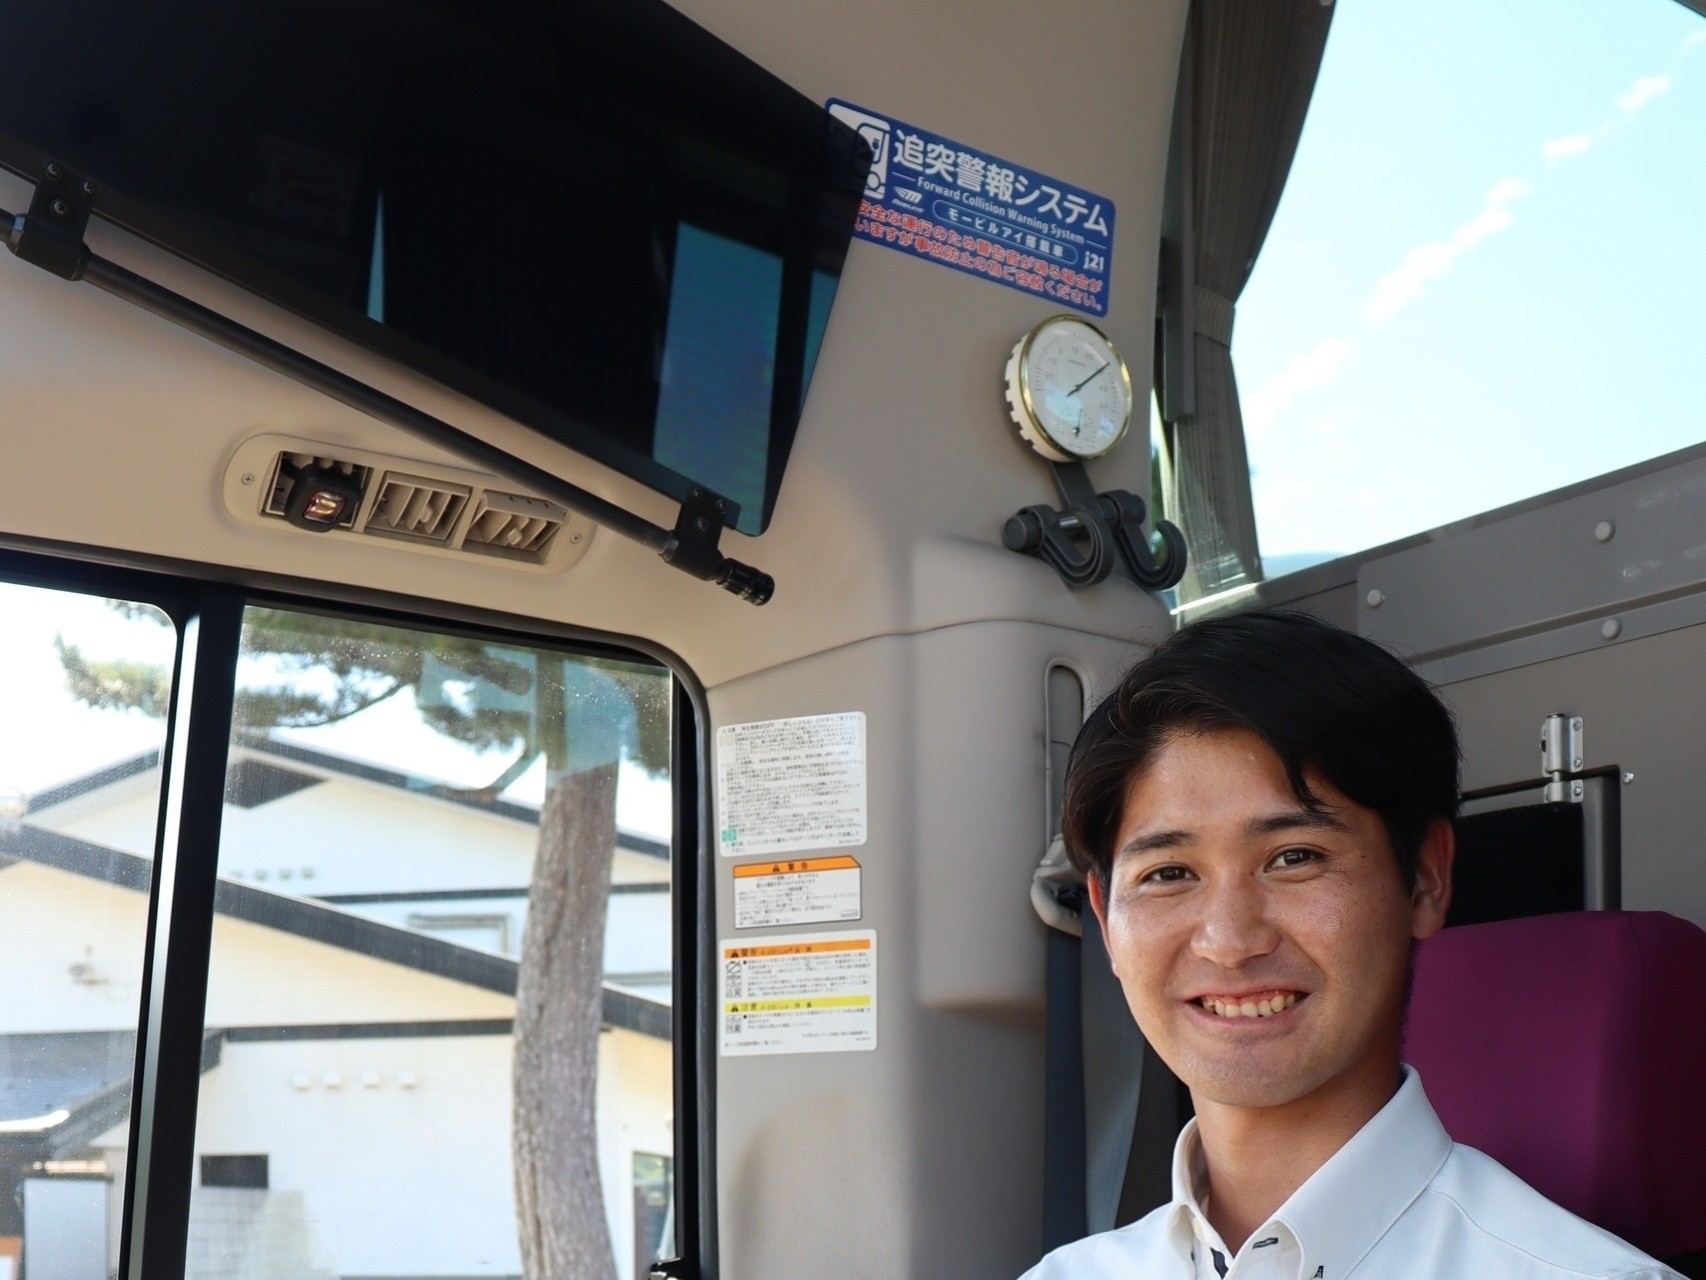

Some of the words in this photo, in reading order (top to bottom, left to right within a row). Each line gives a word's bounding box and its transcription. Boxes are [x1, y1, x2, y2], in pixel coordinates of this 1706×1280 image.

[893, 129, 1108, 237] 追突警報システム
[918, 176, 961, 200] Forward
[962, 192, 1006, 216] Collision
[1008, 207, 1049, 234] Warning
[1050, 223, 1085, 244] System
